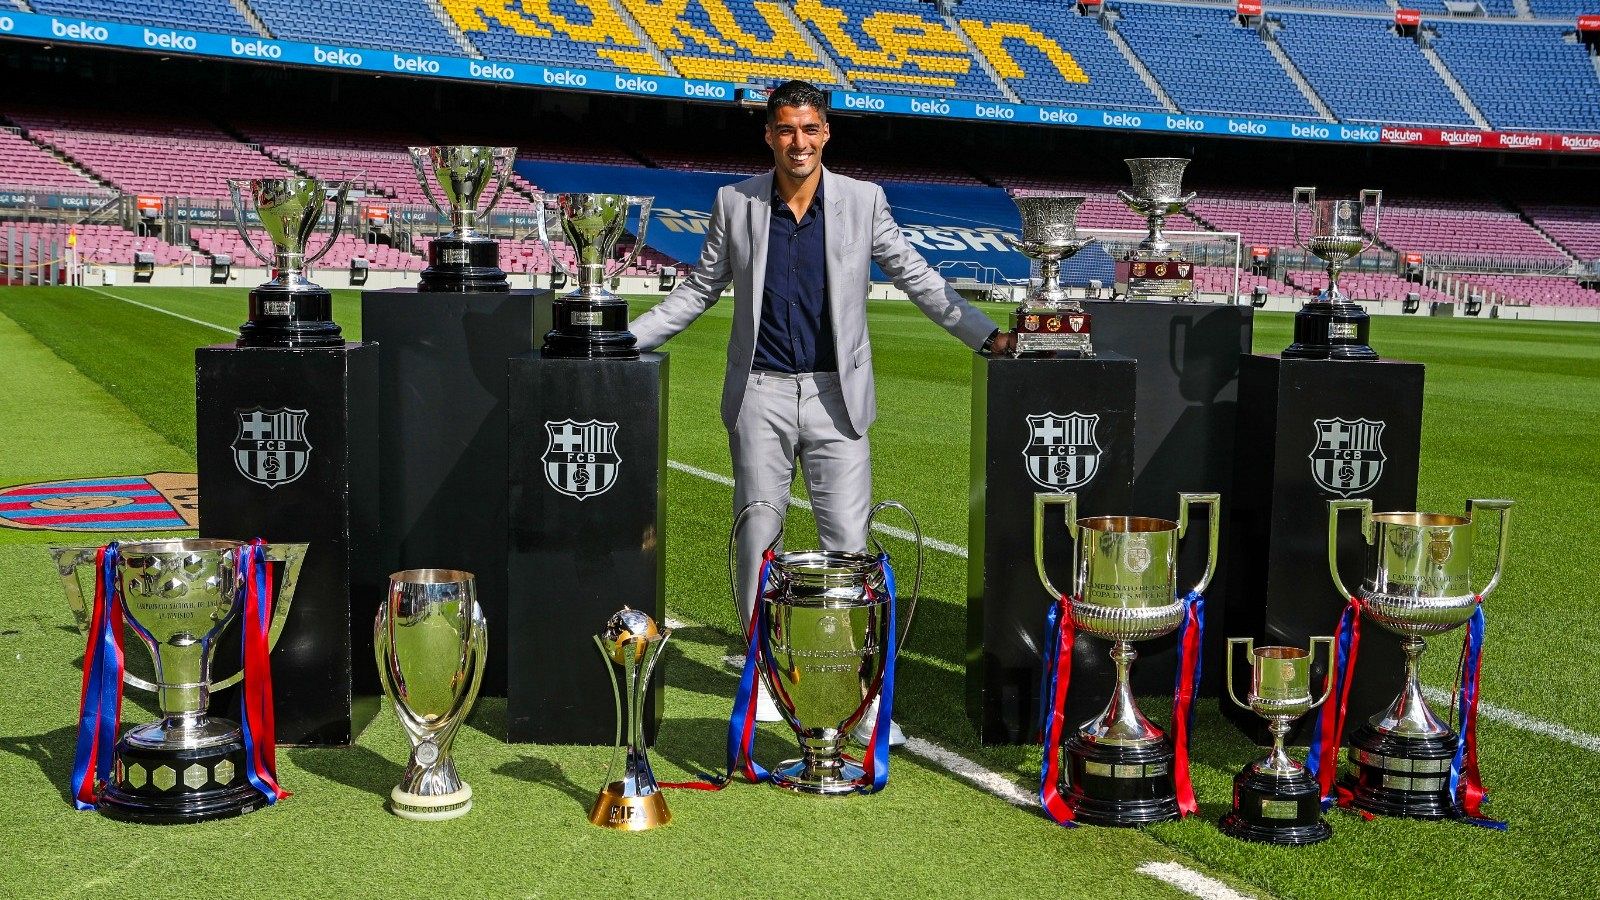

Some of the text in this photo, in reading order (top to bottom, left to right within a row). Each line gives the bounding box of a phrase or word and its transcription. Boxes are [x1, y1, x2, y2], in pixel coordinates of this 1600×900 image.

[52, 18, 108, 41] beko
[145, 28, 197, 50] beko
[231, 38, 282, 59] beko
[314, 46, 362, 66] beko
[393, 54, 440, 73] beko
[469, 61, 515, 80] beko
[543, 68, 587, 87] beko
[615, 74, 658, 93] beko
[684, 80, 726, 98] beko
[845, 93, 885, 110] beko
[911, 98, 950, 115] beko
[975, 103, 1015, 119] beko
[1039, 108, 1078, 123] beko
[1103, 112, 1142, 127] beko
[1166, 116, 1204, 131] beko
[1228, 119, 1267, 134] beko
[1291, 123, 1329, 139] beko
[1340, 126, 1379, 141] beko
[1381, 128, 1422, 141] Rakuten
[1441, 131, 1481, 144] Rakuten
[1499, 134, 1541, 146] Rakuten
[257, 440, 286, 450] FCB
[1048, 446, 1076, 456] FCB
[567, 453, 596, 463] FCB
[1334, 449, 1362, 460] FCB
